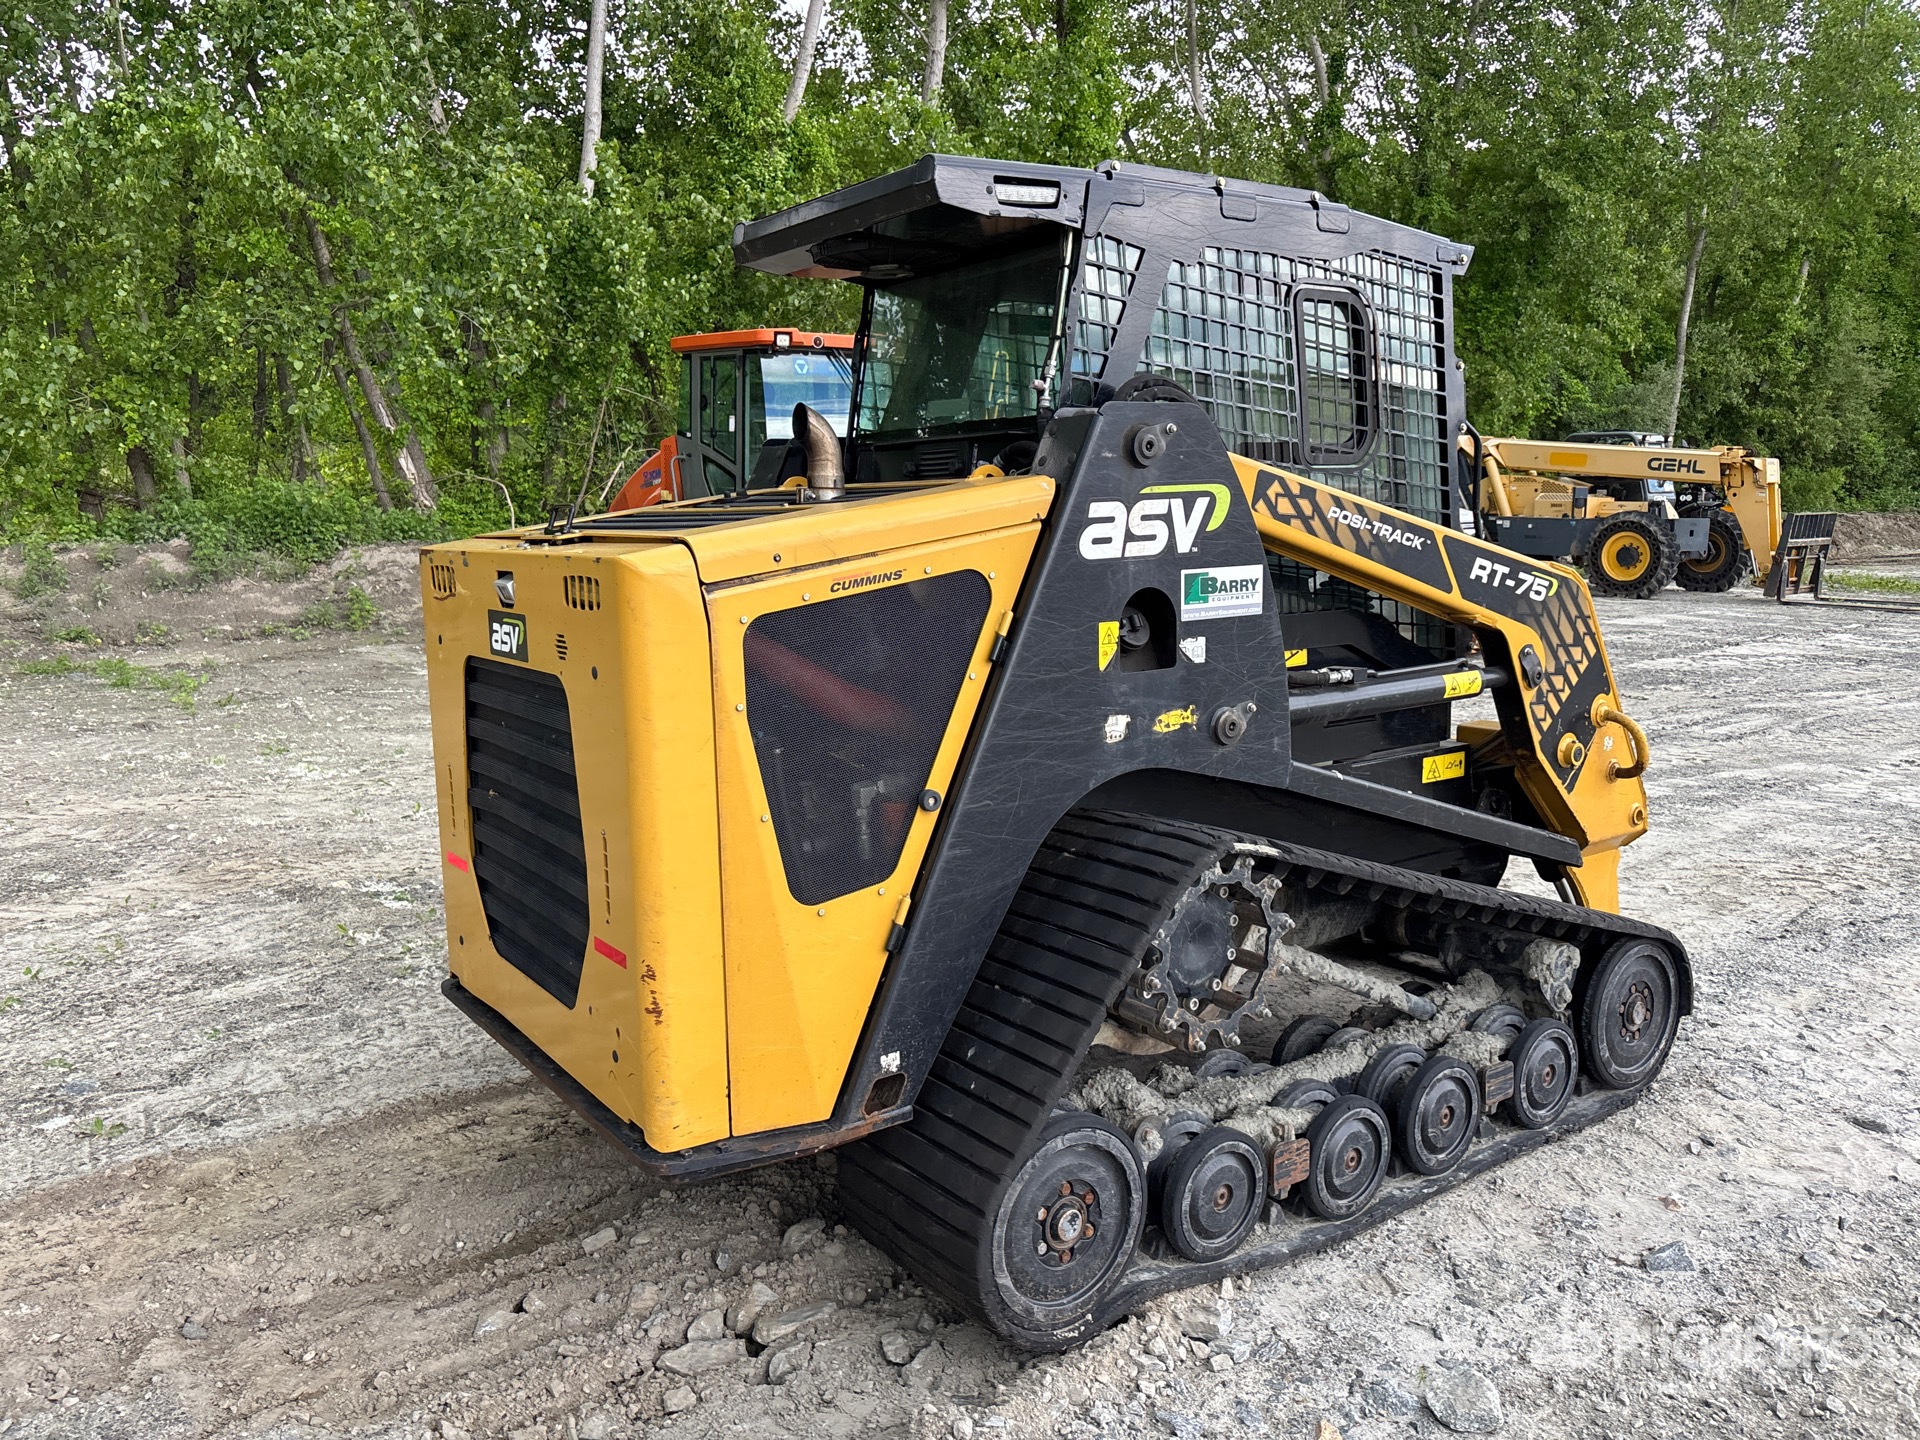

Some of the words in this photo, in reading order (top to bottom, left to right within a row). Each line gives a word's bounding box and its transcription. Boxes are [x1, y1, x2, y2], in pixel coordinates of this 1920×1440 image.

[1647, 457, 1706, 474] GEHL
[1327, 506, 1425, 551] POSI-TRACK
[830, 569, 903, 593] CUMMINS
[1200, 576, 1260, 595] BARRY
[1469, 557, 1550, 601] RT-75
[1212, 594, 1255, 602] EQUIPMENT
